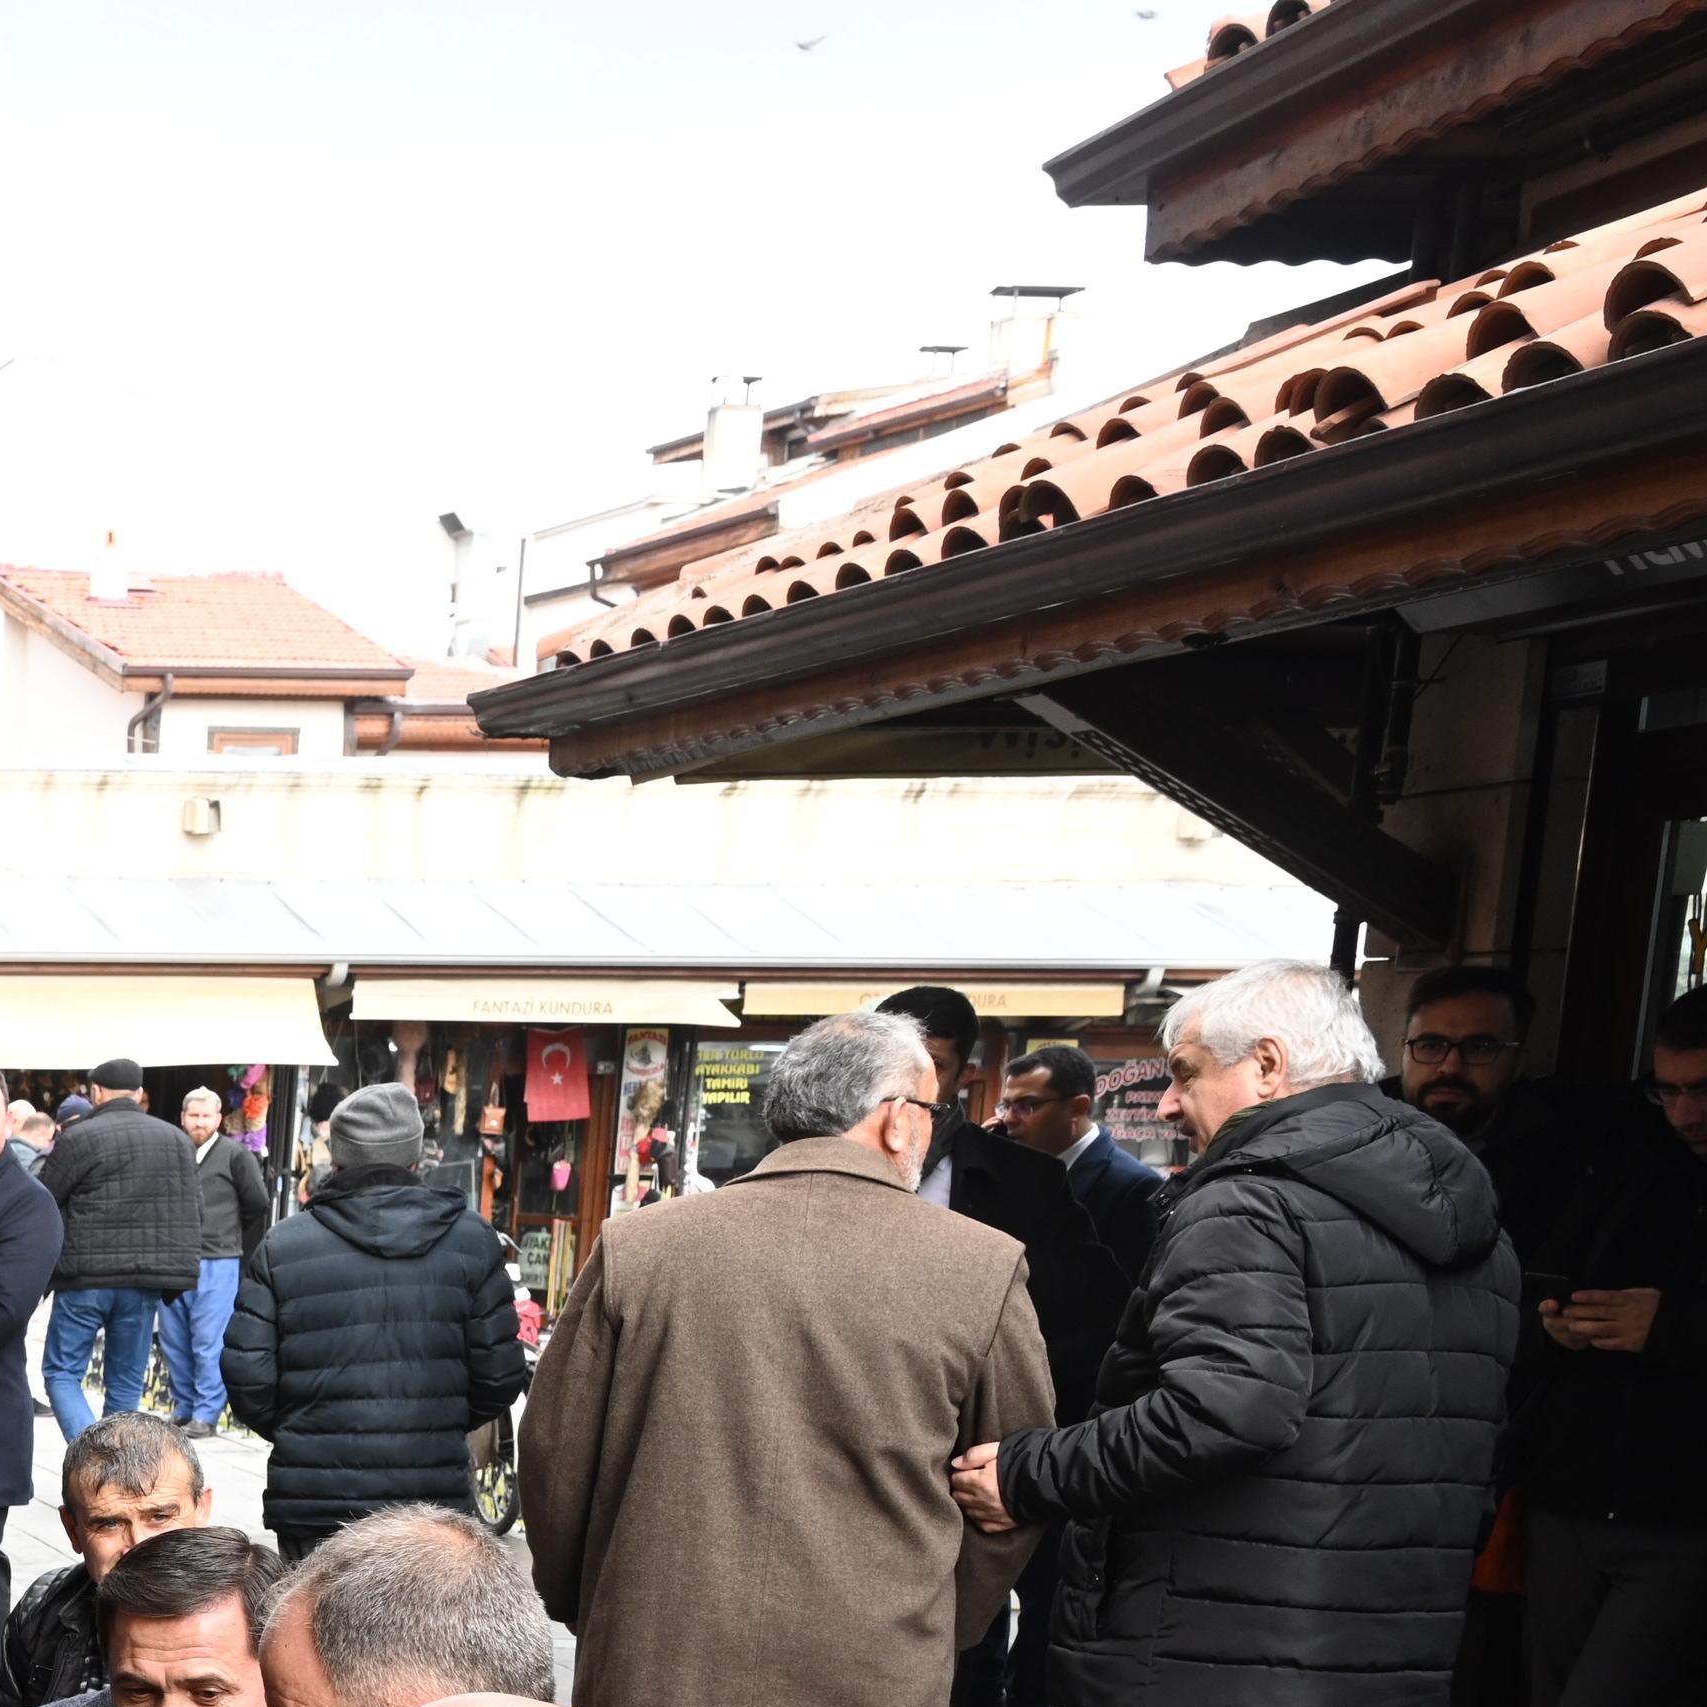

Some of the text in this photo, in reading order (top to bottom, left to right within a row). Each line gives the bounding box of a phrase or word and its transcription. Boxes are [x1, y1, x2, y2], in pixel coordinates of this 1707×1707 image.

[473, 998, 614, 1016] FANTAZİ KUNDURA
[695, 1063, 760, 1076] AYAKKABI
[702, 1091, 751, 1105] YAPILIR
